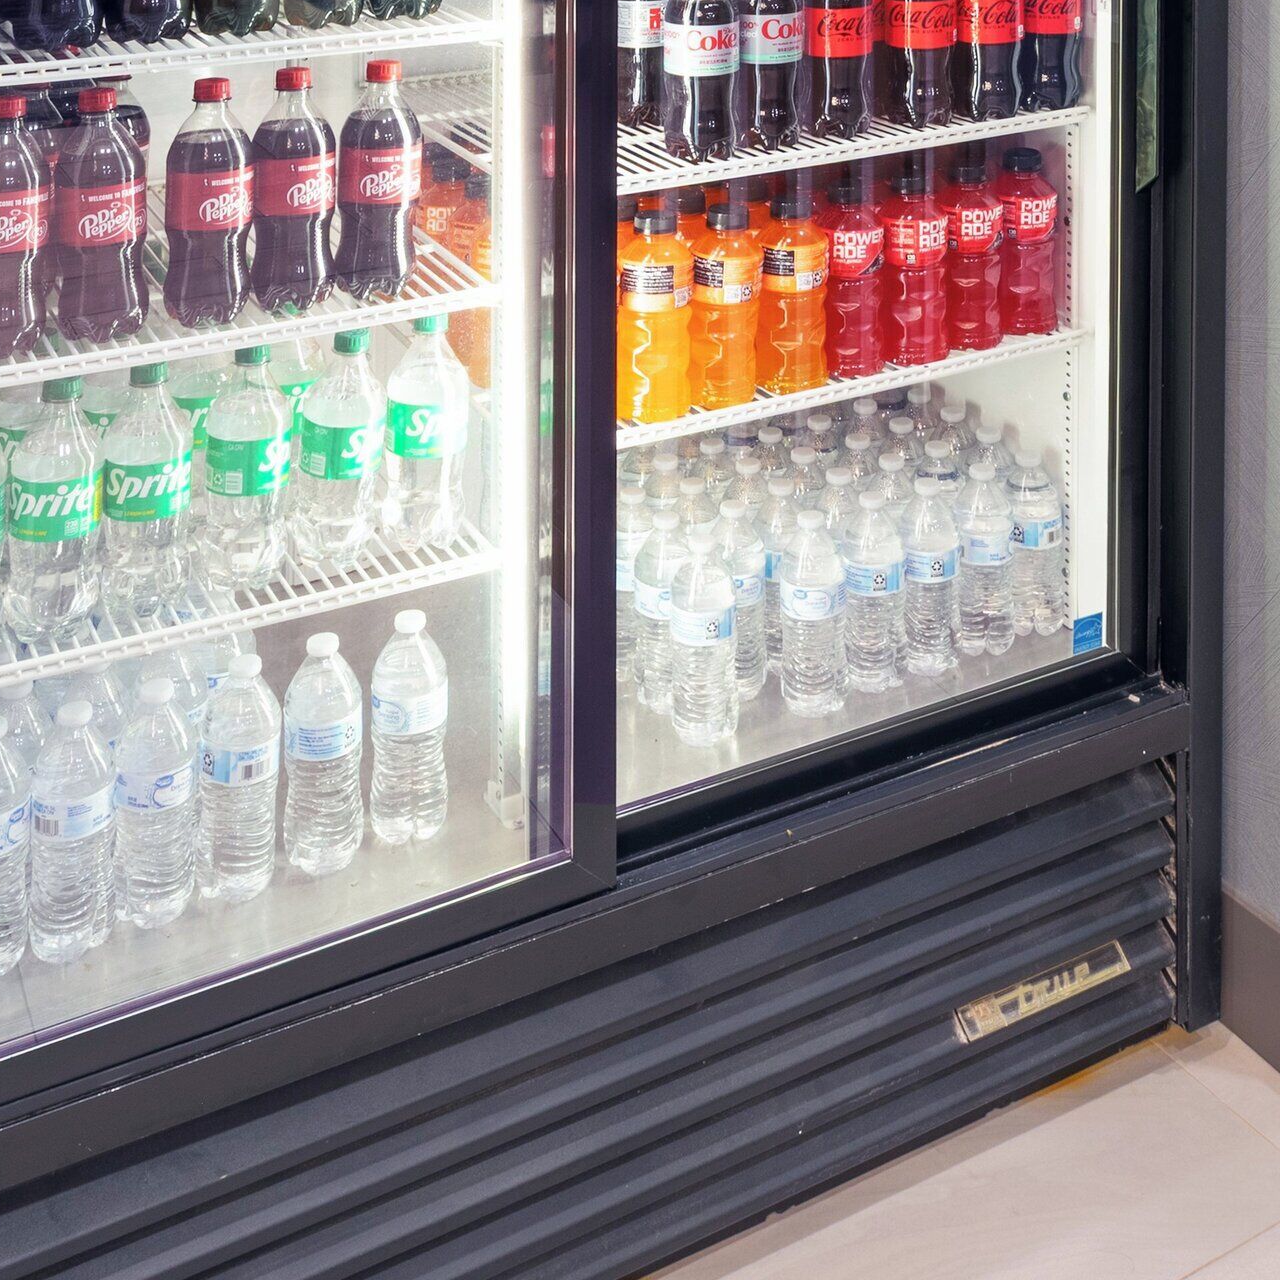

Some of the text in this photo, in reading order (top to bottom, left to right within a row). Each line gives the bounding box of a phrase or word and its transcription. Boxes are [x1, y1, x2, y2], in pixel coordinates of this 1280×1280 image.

[889, 3, 955, 29] Coca-Cola
[686, 28, 738, 52] Coke
[378, 170, 397, 184] Dr
[88, 193, 114, 202] WELCOME
[97, 208, 119, 224] Dr
[1020, 210, 1050, 224] ADE
[83, 210, 130, 239] Pepper
[961, 222, 992, 236] ADE
[919, 231, 946, 248] ADE
[832, 245, 867, 259] ADE
[107, 461, 191, 504] Sprite
[10, 482, 94, 520] Sprite
